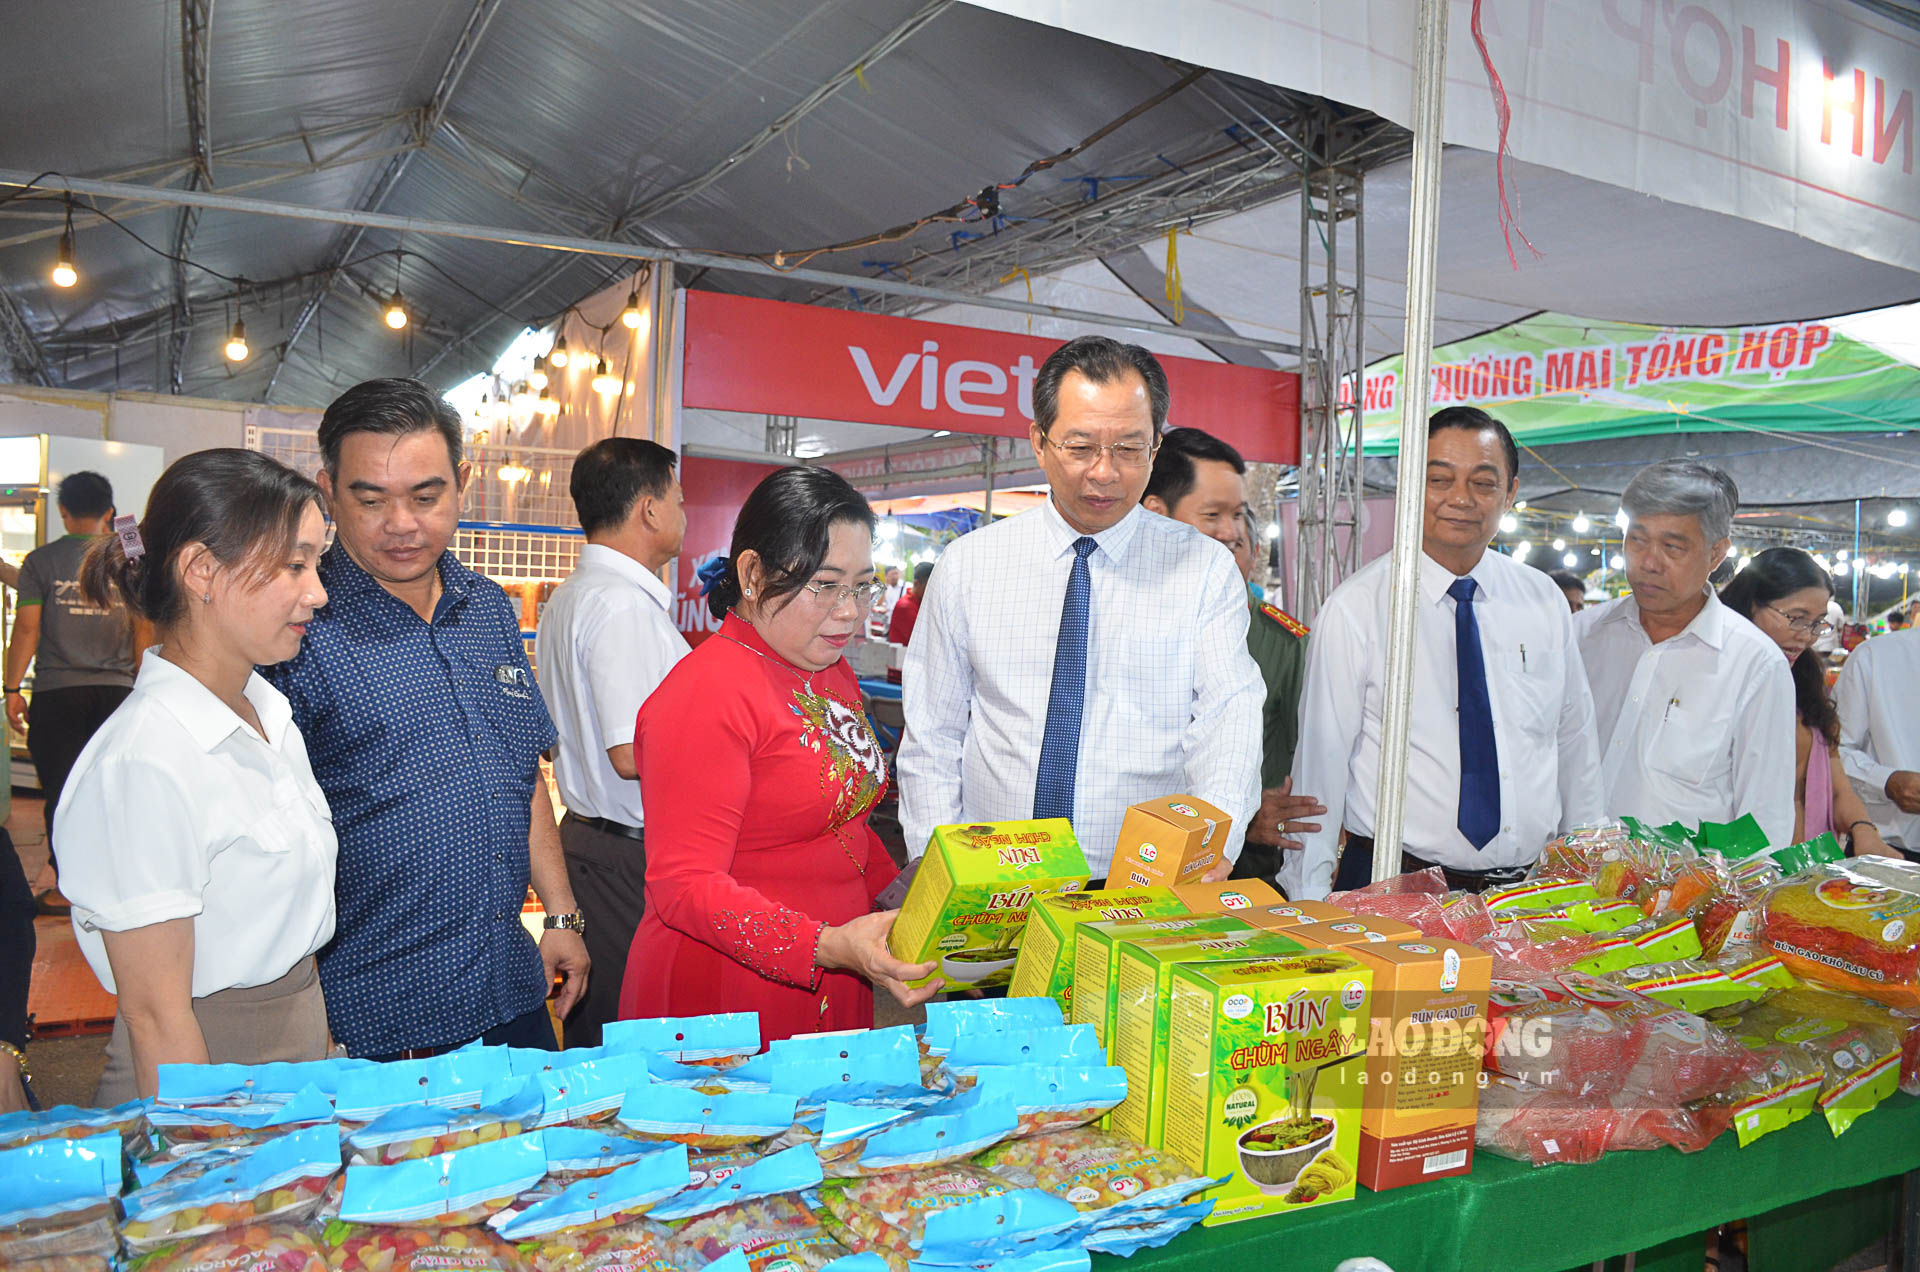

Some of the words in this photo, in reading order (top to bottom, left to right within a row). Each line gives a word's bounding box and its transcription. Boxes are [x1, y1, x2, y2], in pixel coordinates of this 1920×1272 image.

[1432, 355, 1532, 402] HƯƠNG
[1545, 348, 1611, 398] MẠI
[1735, 321, 1830, 377] HỢP
[848, 340, 1040, 421] viet
[1014, 832, 1051, 845] CHÙM
[998, 847, 1042, 870] BÚN
[1144, 848, 1156, 858] LC
[1224, 898, 1240, 906] LC
[953, 911, 1003, 926] CHÙM
[1774, 941, 1795, 955] BÚN
[1797, 947, 1819, 961] GẠO
[1820, 954, 1844, 969] KHÔ
[1844, 962, 1867, 976] RAU
[1227, 998, 1249, 1006] OCOP
[1349, 990, 1362, 1000] LC
[1265, 987, 1330, 1036] BÚN
[1411, 1010, 1434, 1025] BÚN
[1436, 1007, 1458, 1022] GẠO
[1231, 1040, 1288, 1070] CHÙM
[1295, 1029, 1356, 1062] NGÂY
[1226, 1100, 1255, 1110] NATURAL
[715, 1169, 732, 1179] LC
[1113, 1178, 1133, 1192] LC
